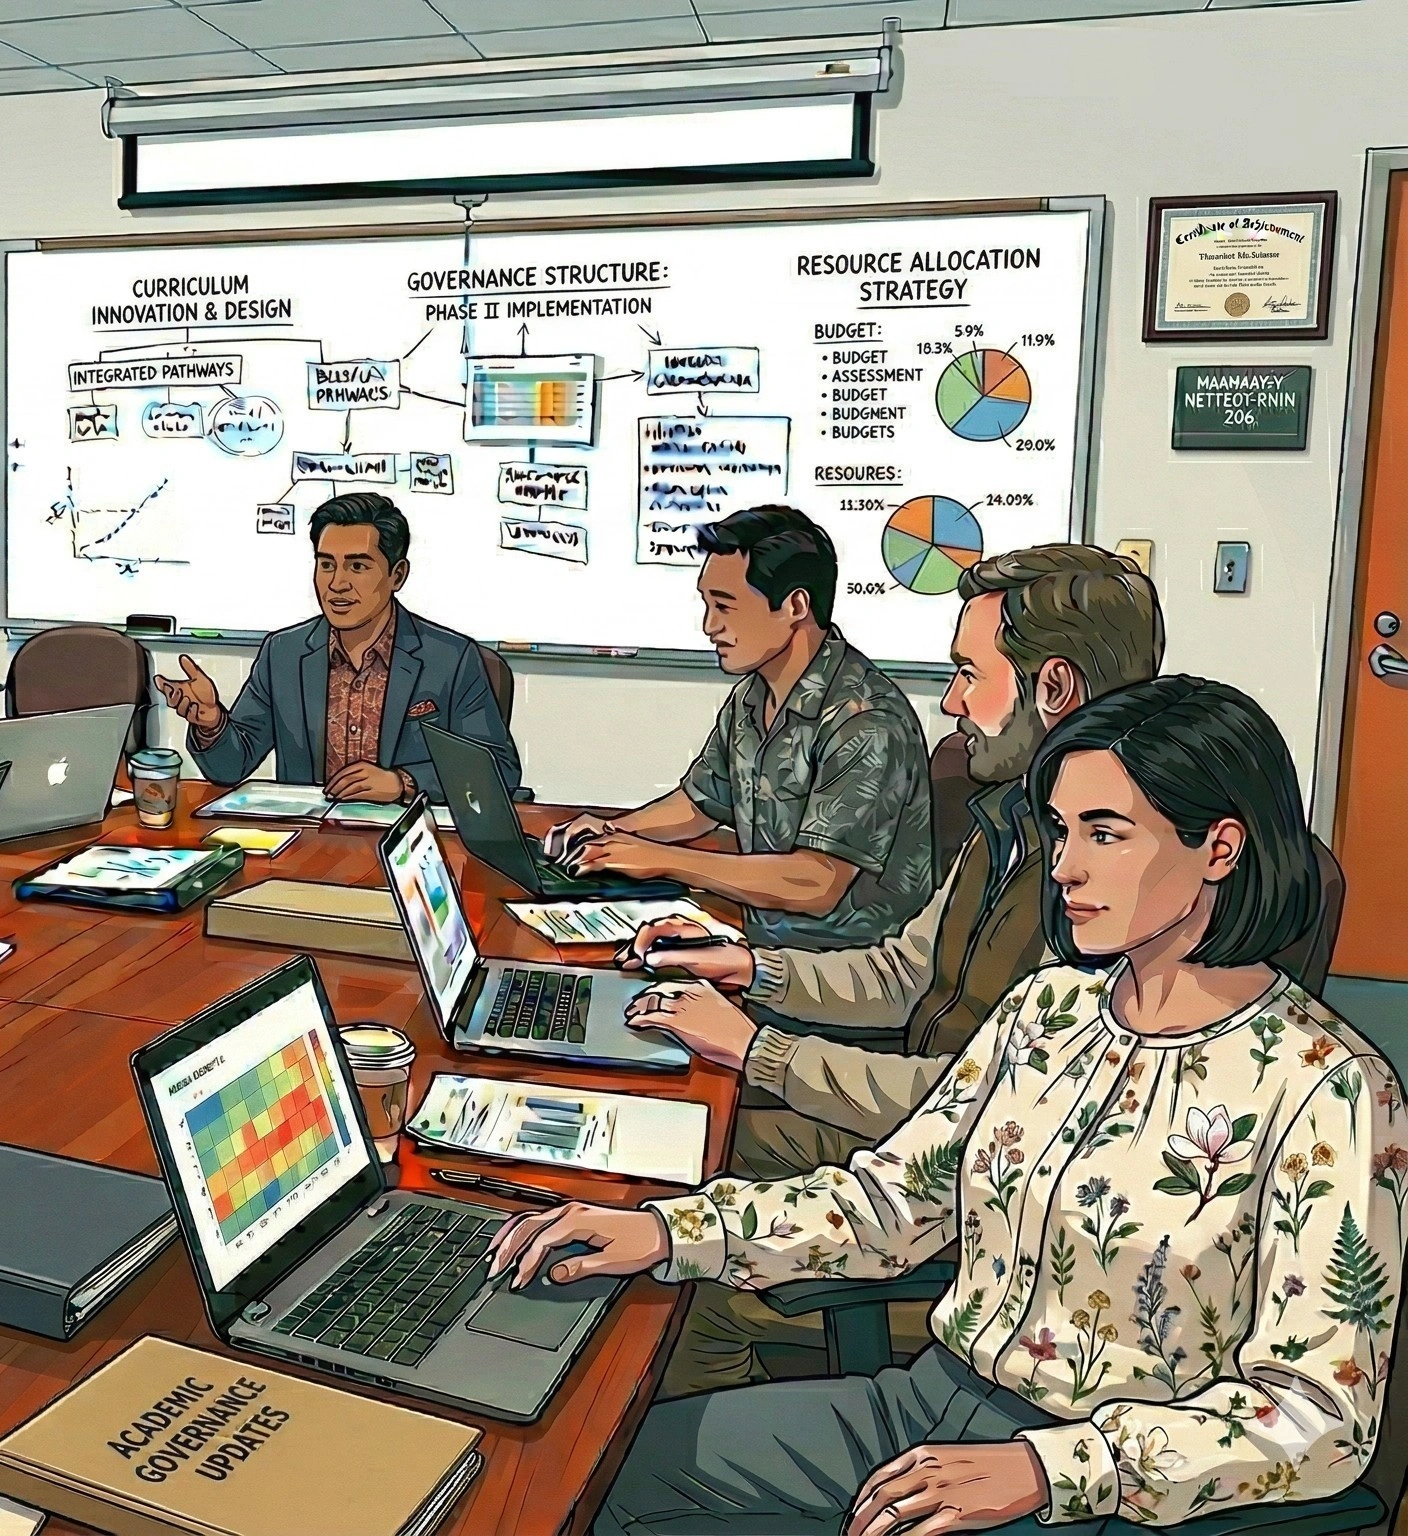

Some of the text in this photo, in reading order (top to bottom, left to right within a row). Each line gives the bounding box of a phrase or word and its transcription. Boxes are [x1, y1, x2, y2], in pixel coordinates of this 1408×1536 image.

[797, 248, 1041, 276] RESOURCE ALLOCATION
[132, 275, 249, 298] CURRICULUM
[407, 261, 669, 292] GOVERNANCE STRUCTURE:
[859, 278, 968, 302] STRATEGY
[92, 298, 292, 325] INNOVATION & DESIGN
[425, 297, 652, 321] PHASE II IMPLEMENTATION
[814, 322, 882, 340] BUDGET:
[1021, 333, 1056, 347] 11.9%
[832, 350, 888, 364] BUDGET
[73, 362, 234, 385] INTEGRATED PATHWAYS
[832, 368, 924, 383] ASSESSMENT
[832, 388, 888, 402] BUDGET
[832, 407, 907, 421] BUDGMENT
[832, 425, 895, 439] BUDGETS
[107, 1376, 214, 1460] ACADEMIC
[135, 1375, 268, 1484] GOVERNANCE
[195, 1405, 290, 1482] UPDATES
